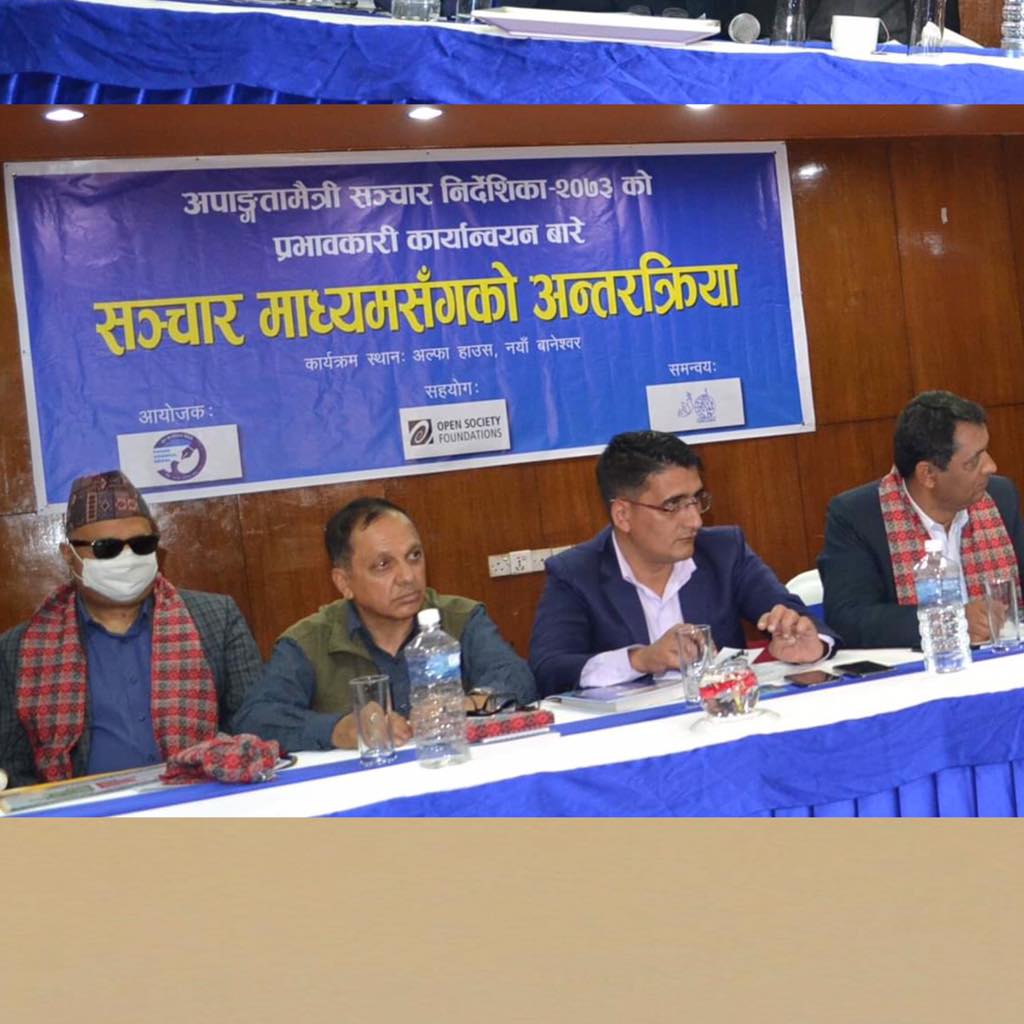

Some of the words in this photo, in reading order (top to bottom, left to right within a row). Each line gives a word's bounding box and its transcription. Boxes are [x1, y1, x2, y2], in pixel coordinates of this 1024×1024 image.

[182, 180, 341, 224] अपाङ्गतामैत्री
[349, 183, 433, 209] सञ्चार
[440, 173, 613, 205] निर्देशिका-२०७३
[621, 169, 653, 196] को
[272, 224, 399, 262] प्रभावकारी
[406, 222, 539, 252] कार्यान्वयन
[545, 216, 586, 244] बारे
[93, 293, 246, 356] सञ्चार
[256, 261, 520, 339] माध्यमसँगको
[529, 251, 740, 322] अन्तरक्रिया
[304, 351, 358, 371] कार्यक्रम
[413, 347, 450, 363] अल्फा
[504, 336, 529, 355] नयाँ
[536, 334, 582, 353] बानेश्वर
[436, 420, 463, 432] OPEN
[464, 416, 502, 429] SOCIETY
[438, 428, 503, 444] FOUNDATIONS
